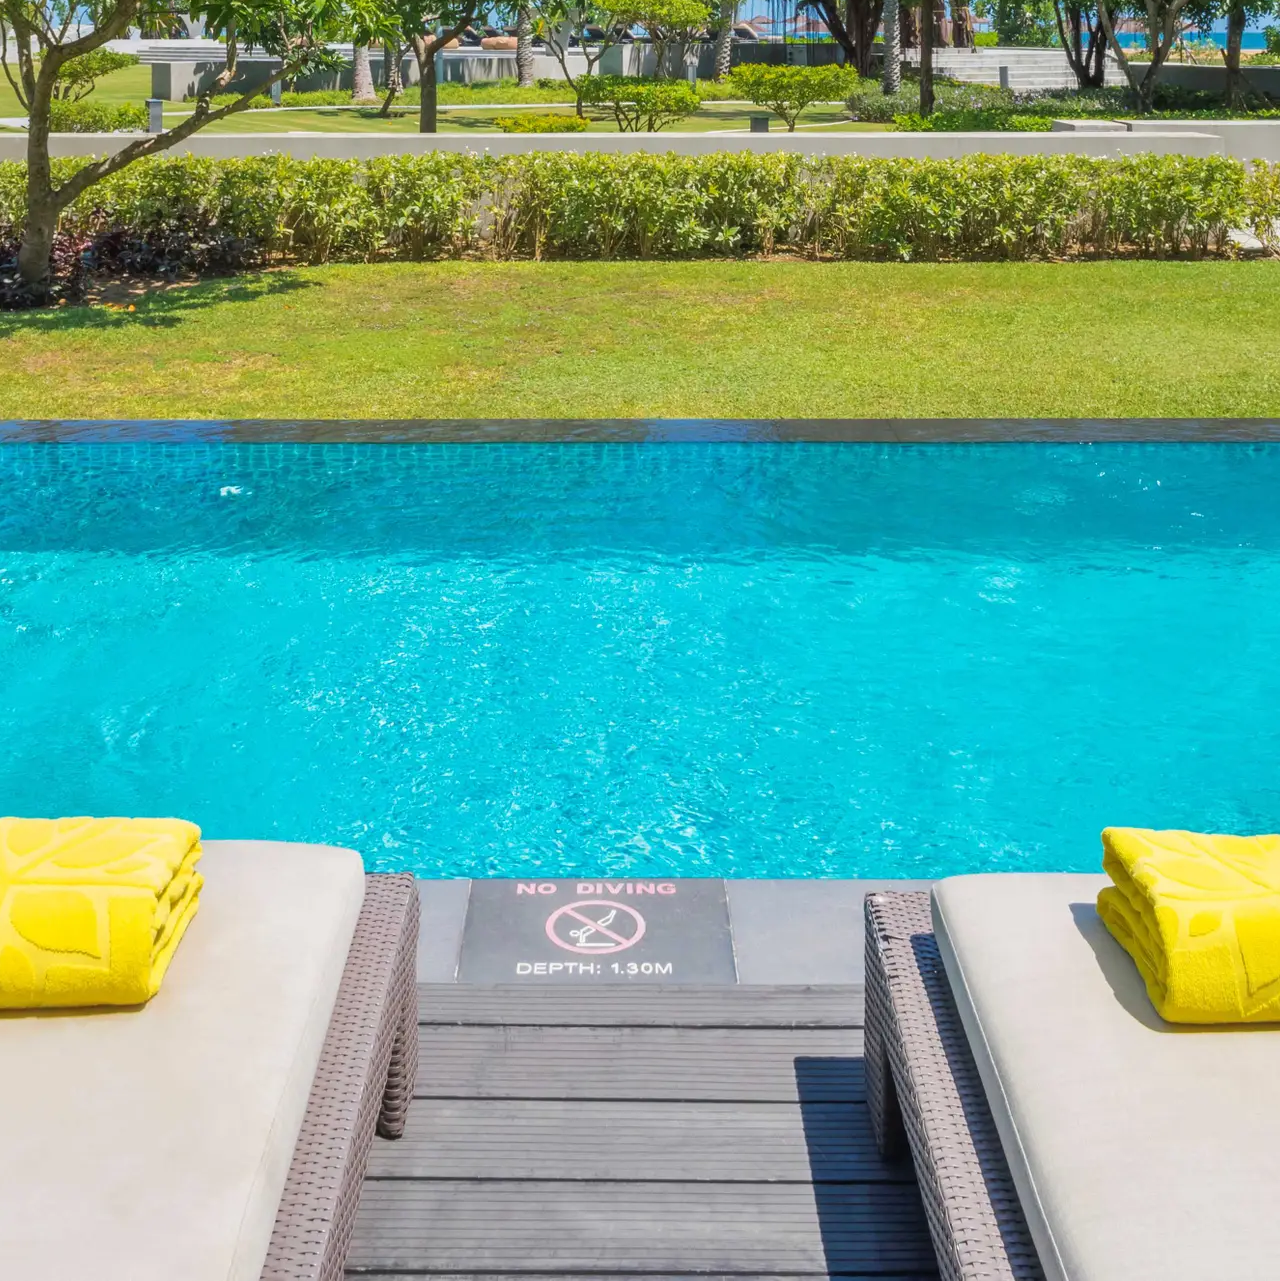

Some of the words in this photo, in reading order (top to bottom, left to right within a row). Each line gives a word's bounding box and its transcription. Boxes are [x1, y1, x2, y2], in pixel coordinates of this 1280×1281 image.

[516, 882, 557, 895] NO
[576, 882, 677, 895] DIVING
[515, 962, 601, 975] DEPTH:
[610, 962, 673, 975] 1.30M
